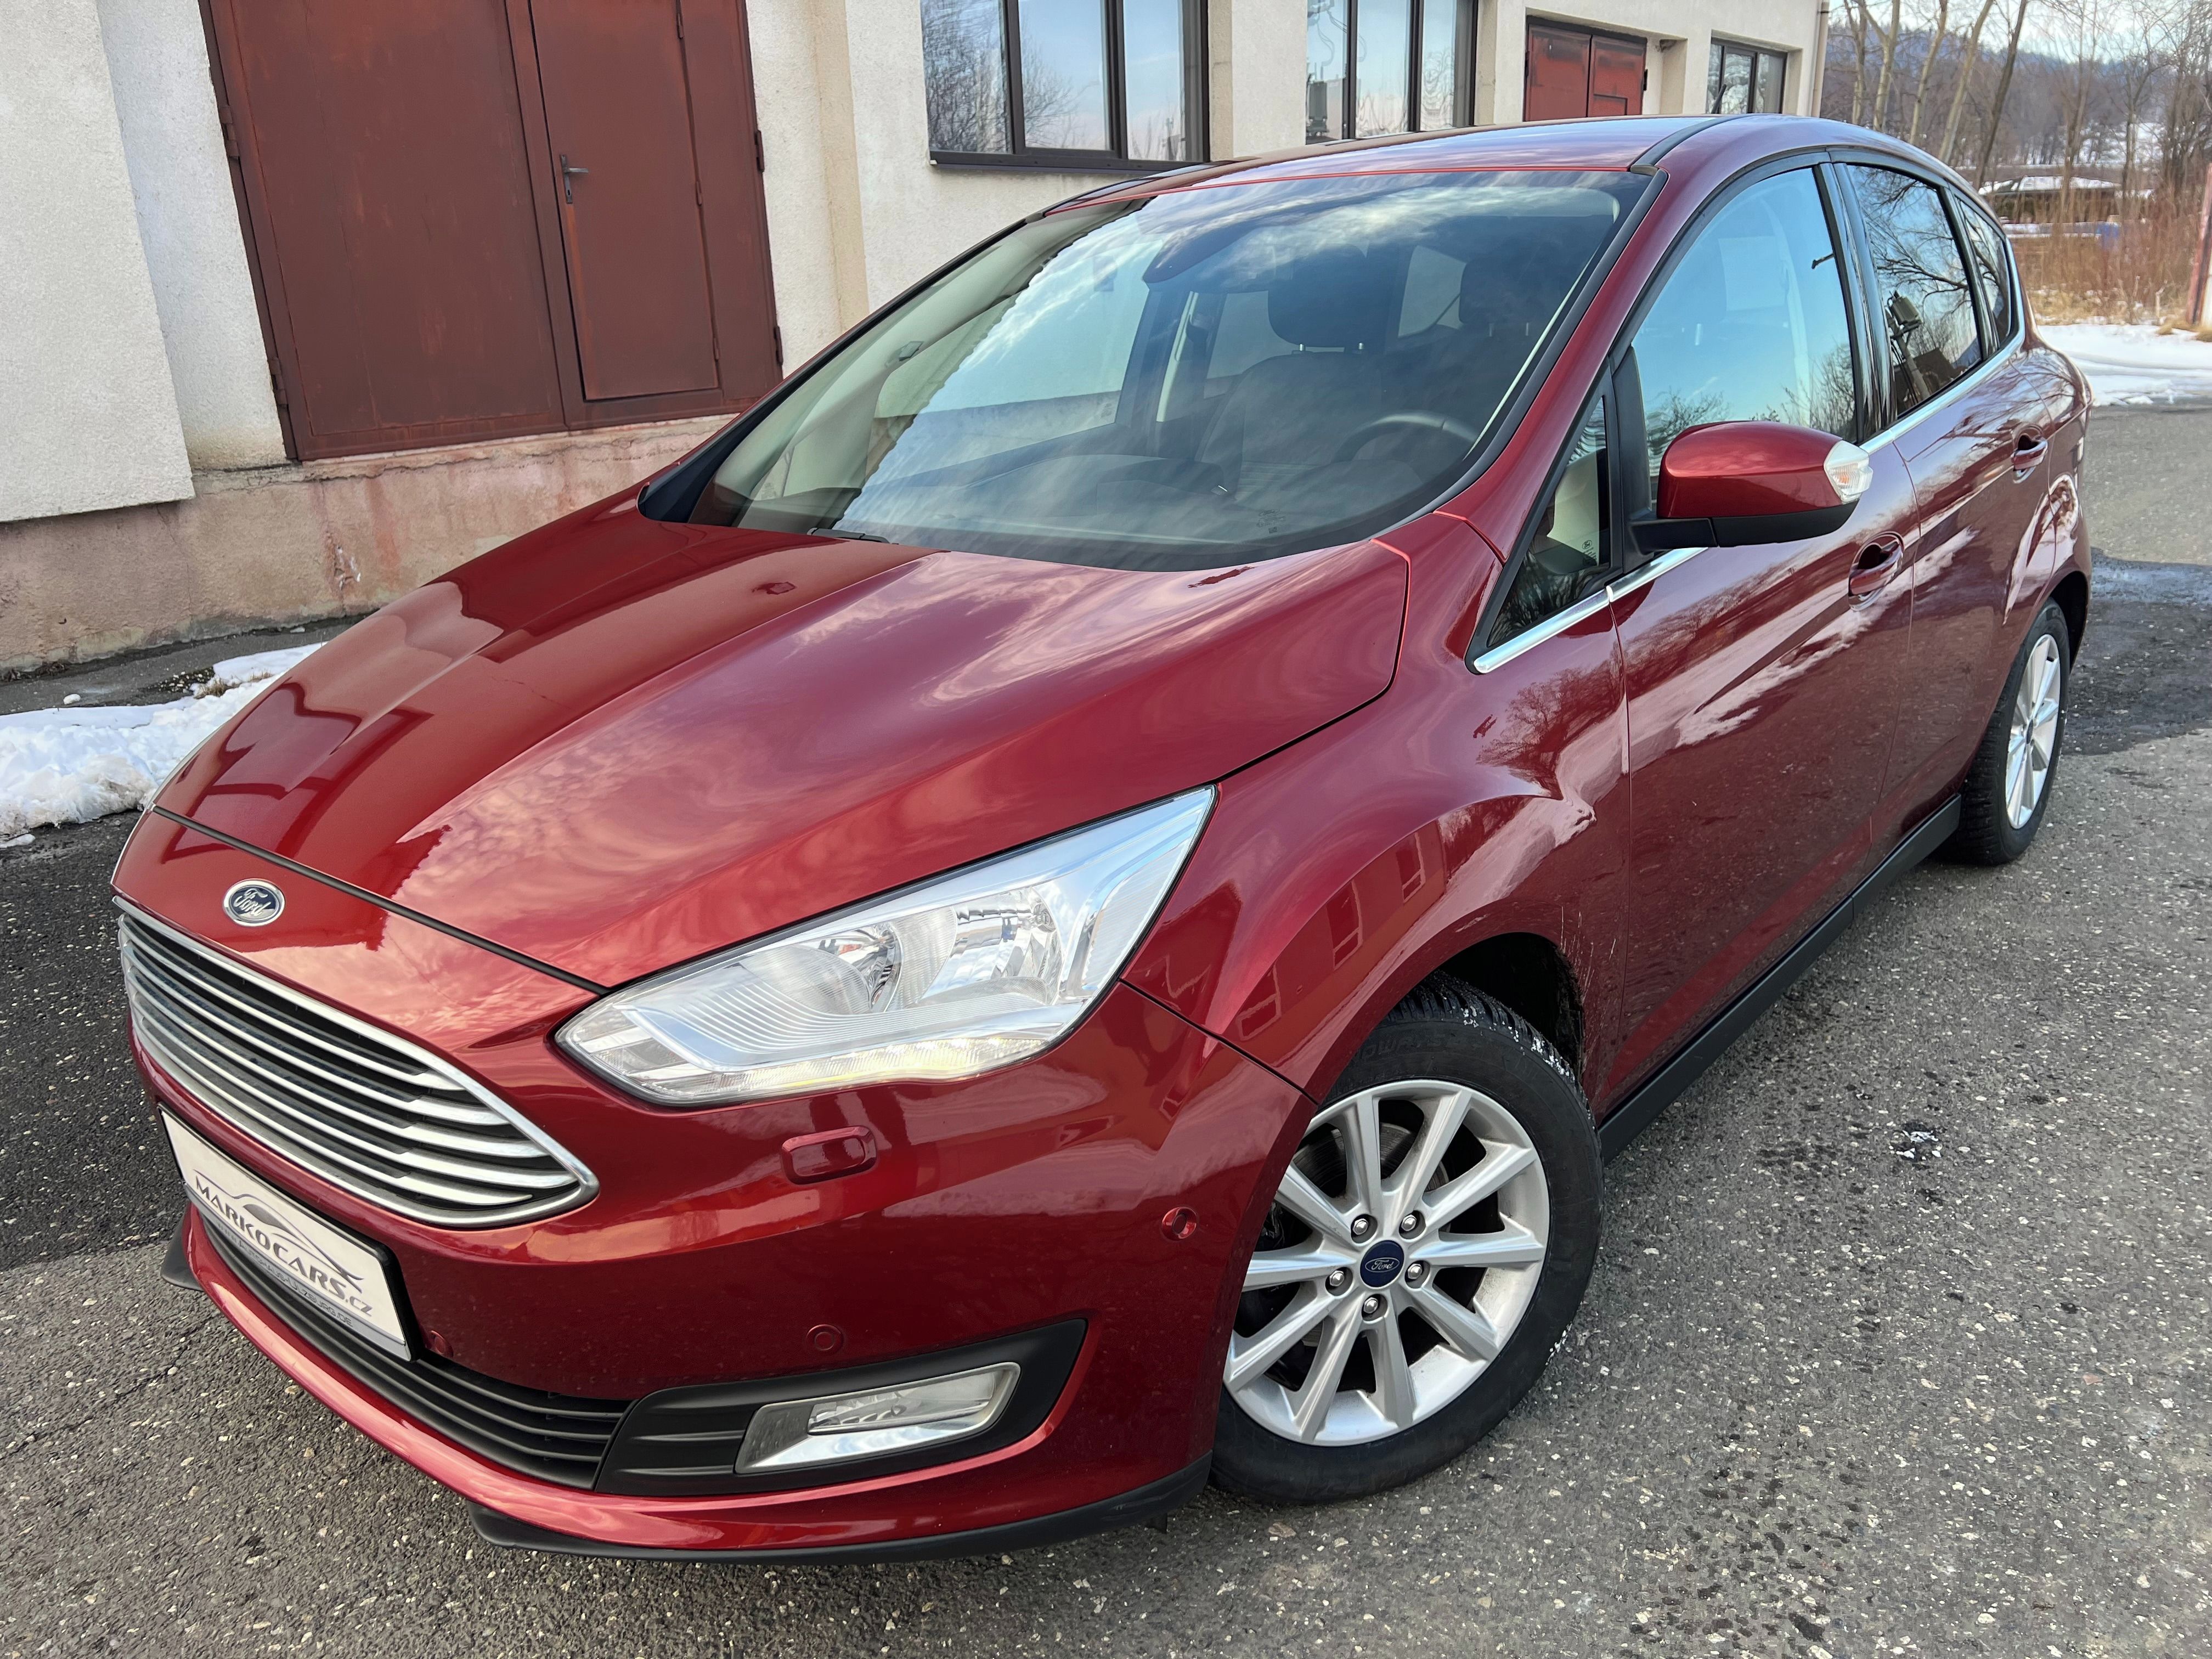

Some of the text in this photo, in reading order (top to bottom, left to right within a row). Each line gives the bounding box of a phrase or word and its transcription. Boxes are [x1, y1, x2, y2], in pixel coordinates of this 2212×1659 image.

[234, 888, 271, 916] Ford
[196, 1176, 373, 1316] MARKOCARS.CZ
[1372, 1260, 1394, 1270] Ford
